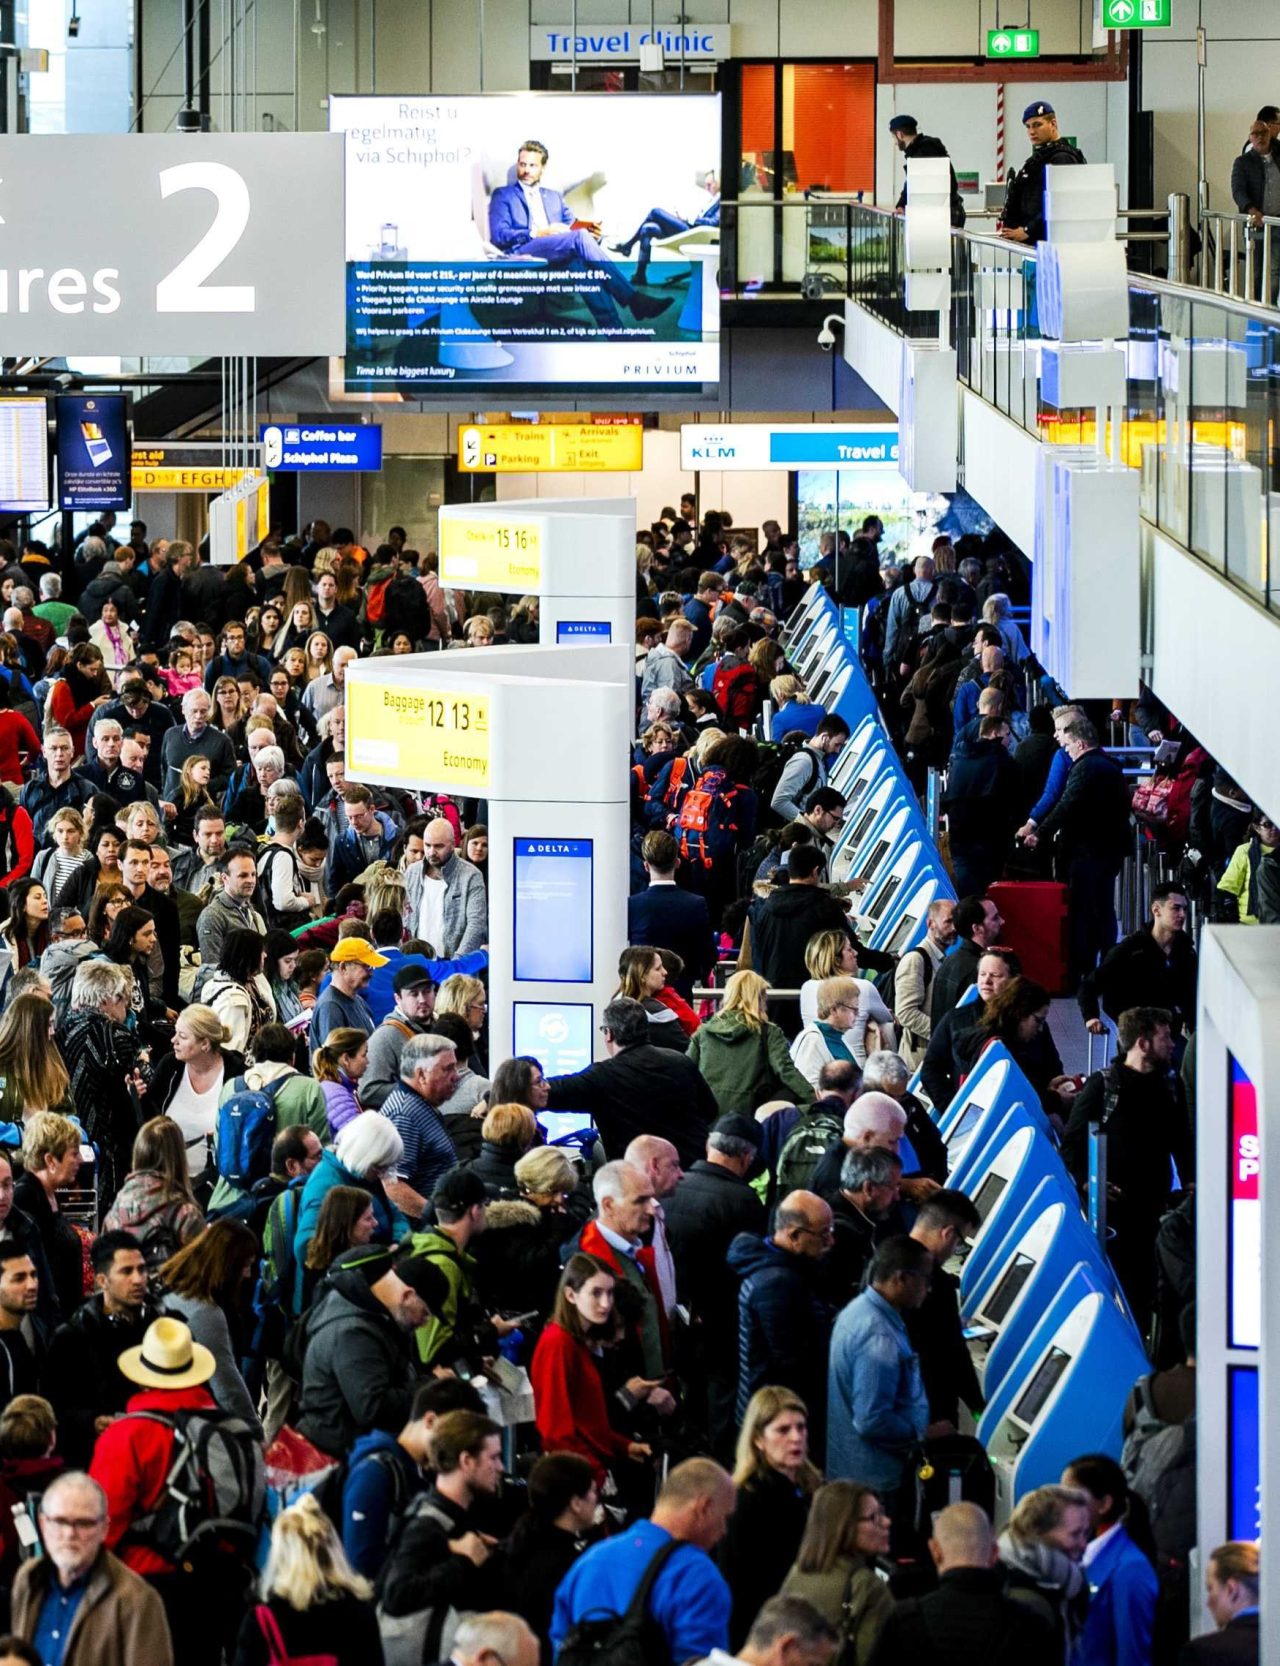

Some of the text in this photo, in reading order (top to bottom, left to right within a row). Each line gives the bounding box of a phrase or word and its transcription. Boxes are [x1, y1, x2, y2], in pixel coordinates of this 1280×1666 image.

[547, 31, 629, 52] Travel
[399, 103, 458, 119] Reist u
[344, 124, 437, 144] regelmatig
[356, 150, 381, 164] via
[156, 161, 255, 313] 2
[356, 366, 456, 378] Time is the biggest luxury
[623, 365, 697, 375] PRIVIUM
[301, 430, 357, 442] Coffee bar
[514, 432, 545, 441] Trains
[579, 427, 619, 437] Arrivals
[283, 452, 359, 466] Schiphol Plaza
[501, 453, 540, 465] Parking
[579, 449, 599, 459] Exit
[692, 448, 736, 457] KLM
[838, 444, 886, 460] Travel
[497, 528, 510, 548] 15
[514, 530, 527, 549] 16
[383, 691, 425, 713] Baggage
[428, 700, 444, 728] 12
[452, 702, 470, 731] 13
[443, 751, 488, 775] Economy
[537, 844, 570, 853] DELTA
